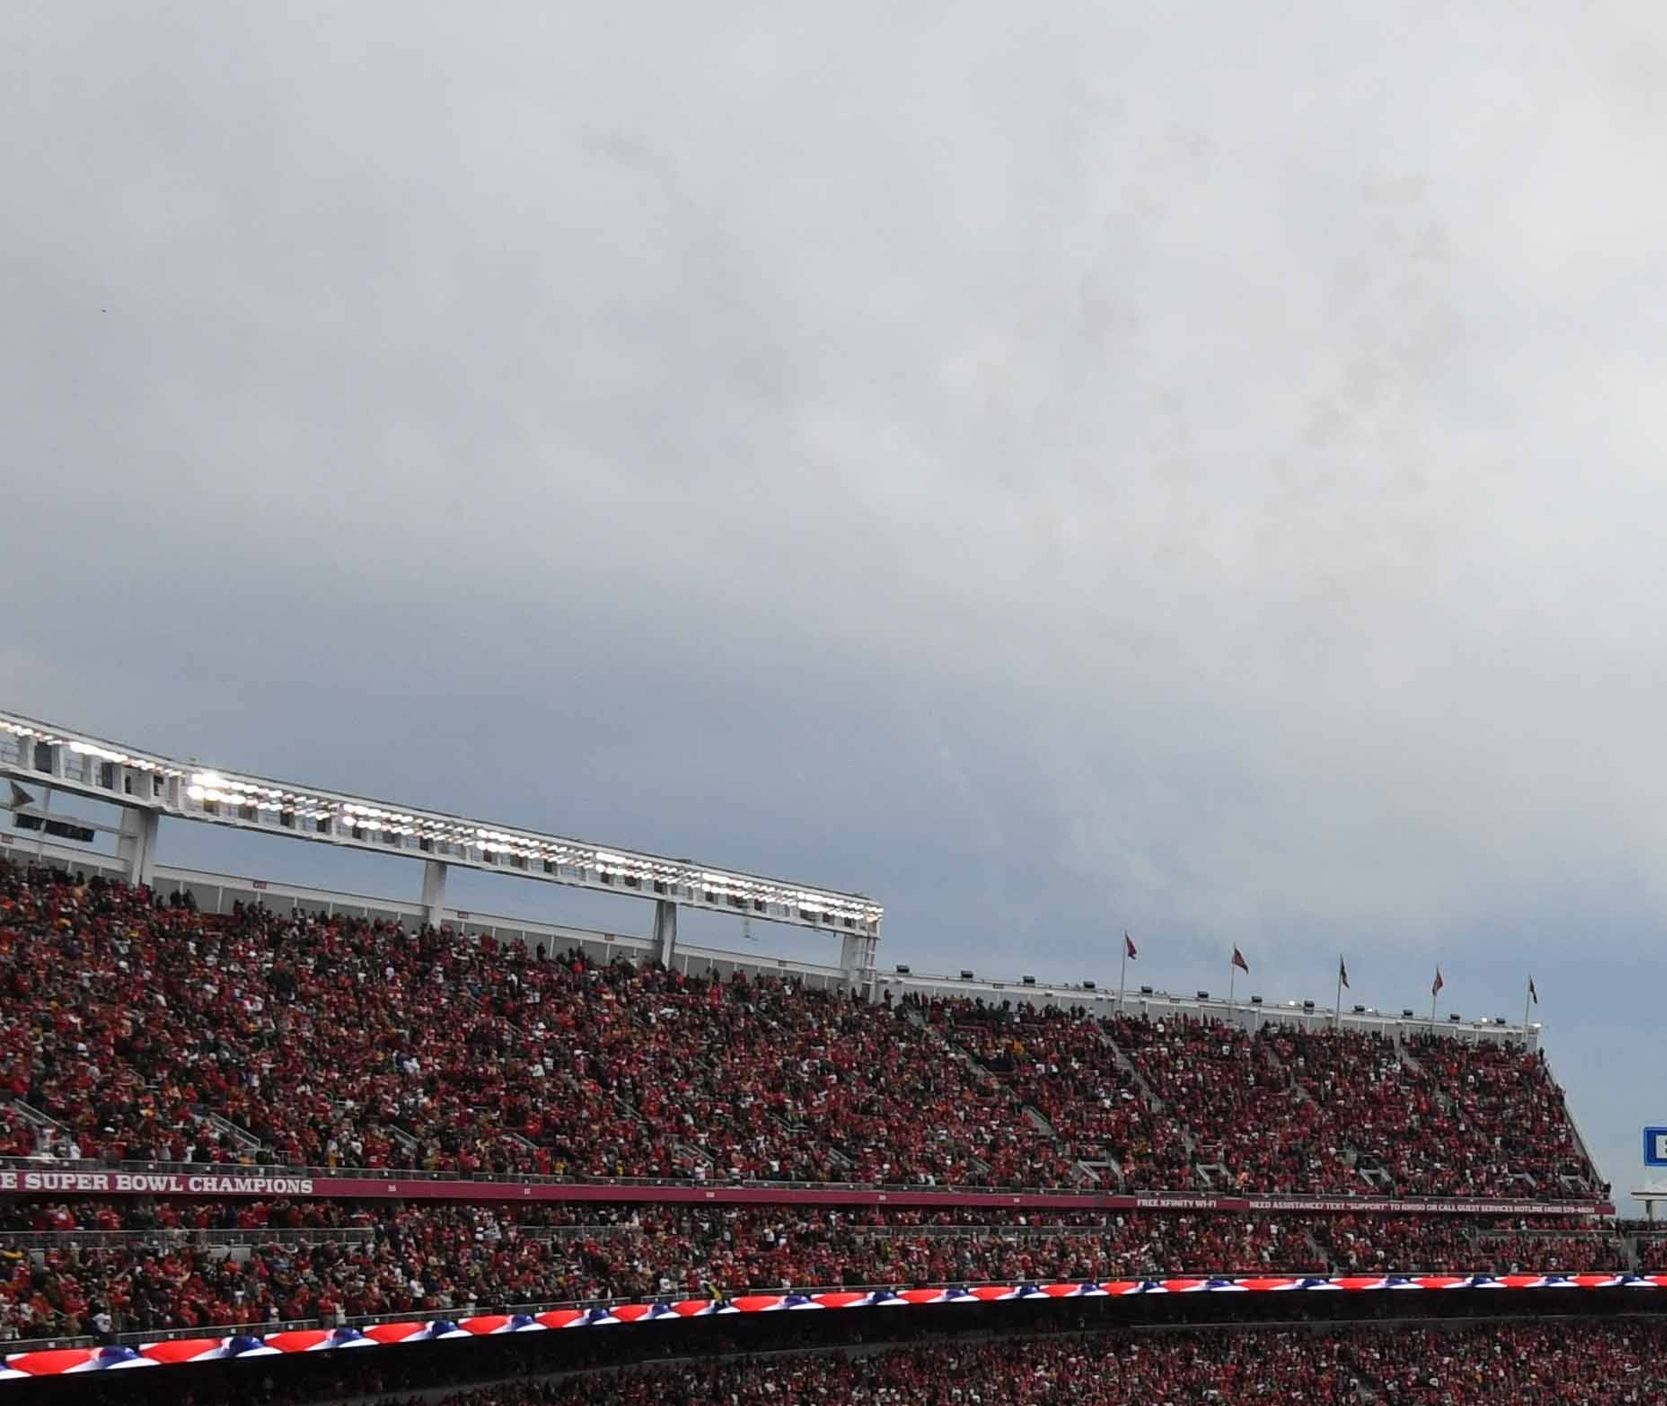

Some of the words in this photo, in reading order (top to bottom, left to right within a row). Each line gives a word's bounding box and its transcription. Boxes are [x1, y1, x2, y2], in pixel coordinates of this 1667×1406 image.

[24, 1173, 109, 1190] SUPER
[116, 1174, 183, 1191] BOWL
[188, 1176, 313, 1194] CHAMPIONS
[1137, 1199, 1158, 1207] FREE
[1160, 1199, 1194, 1207] XFINITY
